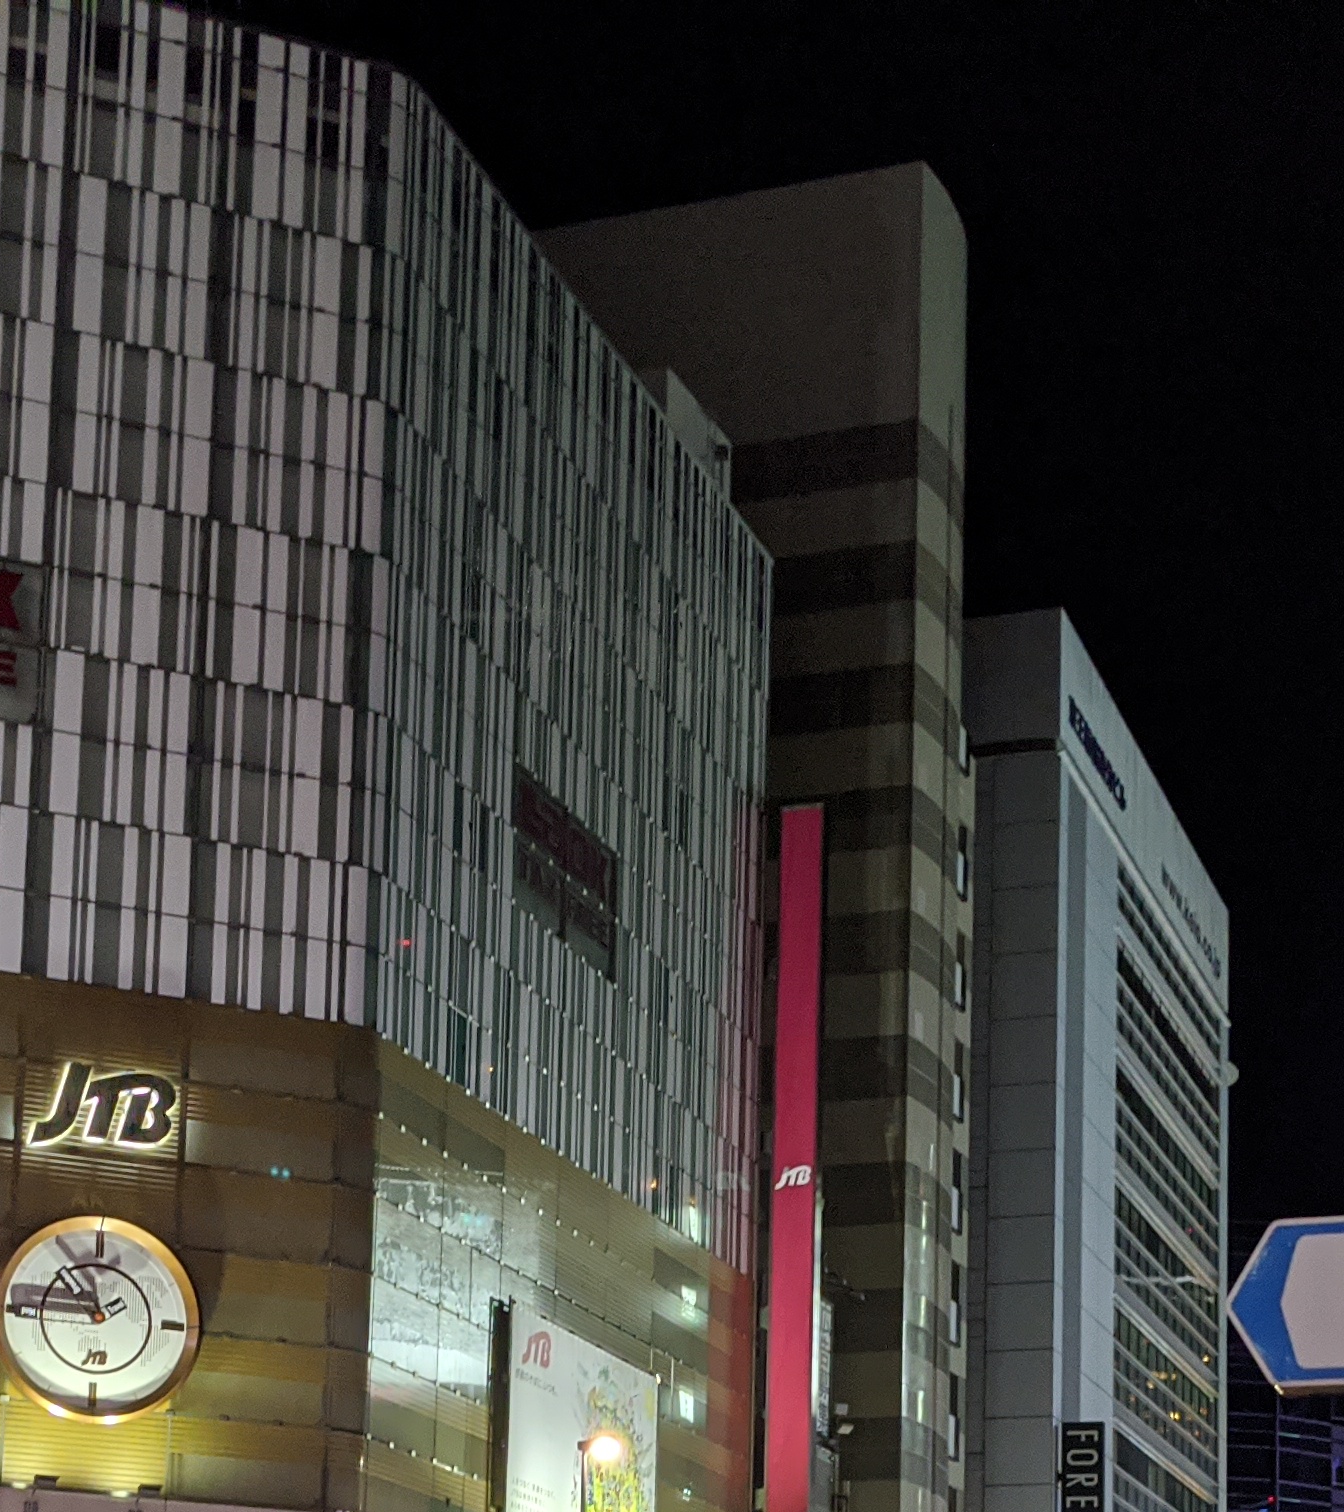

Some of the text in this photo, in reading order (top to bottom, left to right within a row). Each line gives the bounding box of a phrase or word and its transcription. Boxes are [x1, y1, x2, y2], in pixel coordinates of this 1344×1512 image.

[26, 1061, 180, 1149] JTB
[775, 1165, 812, 1191] JTB
[80, 1348, 108, 1367] JTB
[521, 1331, 552, 1369] JTB
